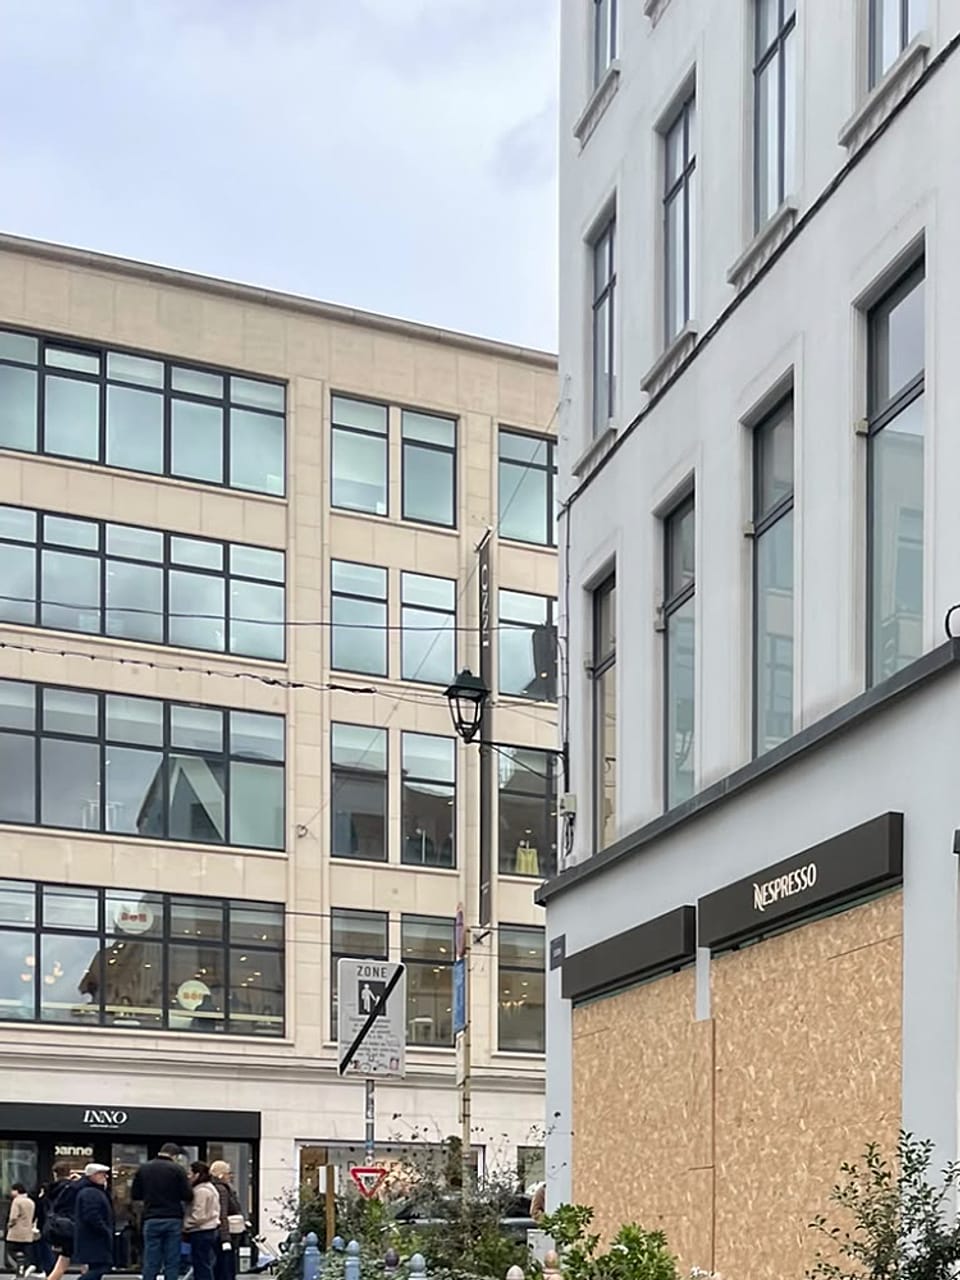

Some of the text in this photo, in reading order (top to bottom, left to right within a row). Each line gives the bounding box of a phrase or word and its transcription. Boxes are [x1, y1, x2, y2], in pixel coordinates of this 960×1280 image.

[481, 563, 489, 647] INNO
[752, 863, 817, 912] NESPRESSO
[356, 965, 388, 978] ZONE
[83, 1109, 128, 1125] INNO
